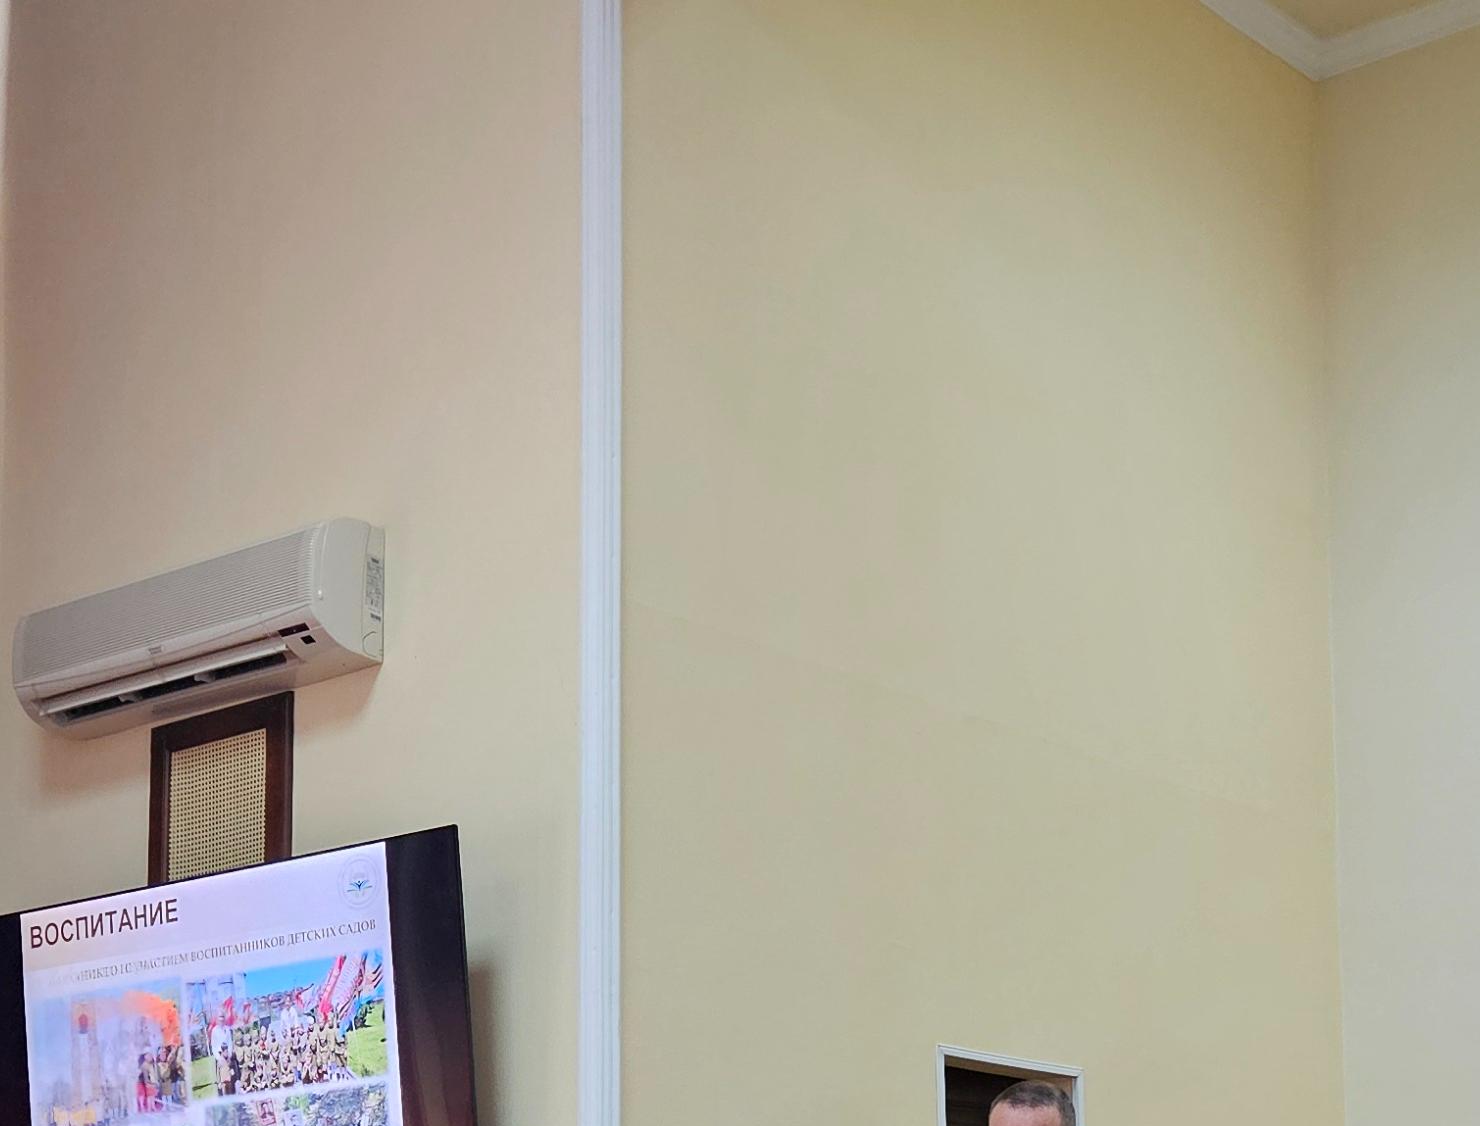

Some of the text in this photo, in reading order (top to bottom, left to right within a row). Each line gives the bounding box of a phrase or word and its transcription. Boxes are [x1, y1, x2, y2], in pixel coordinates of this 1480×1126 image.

[30, 898, 179, 949] ВОСПИТАНИЕ
[190, 935, 285, 962] ВОСПИТАННИКОВ
[286, 926, 336, 946] ДЕТСКИХ
[338, 918, 377, 935] САДОВ
